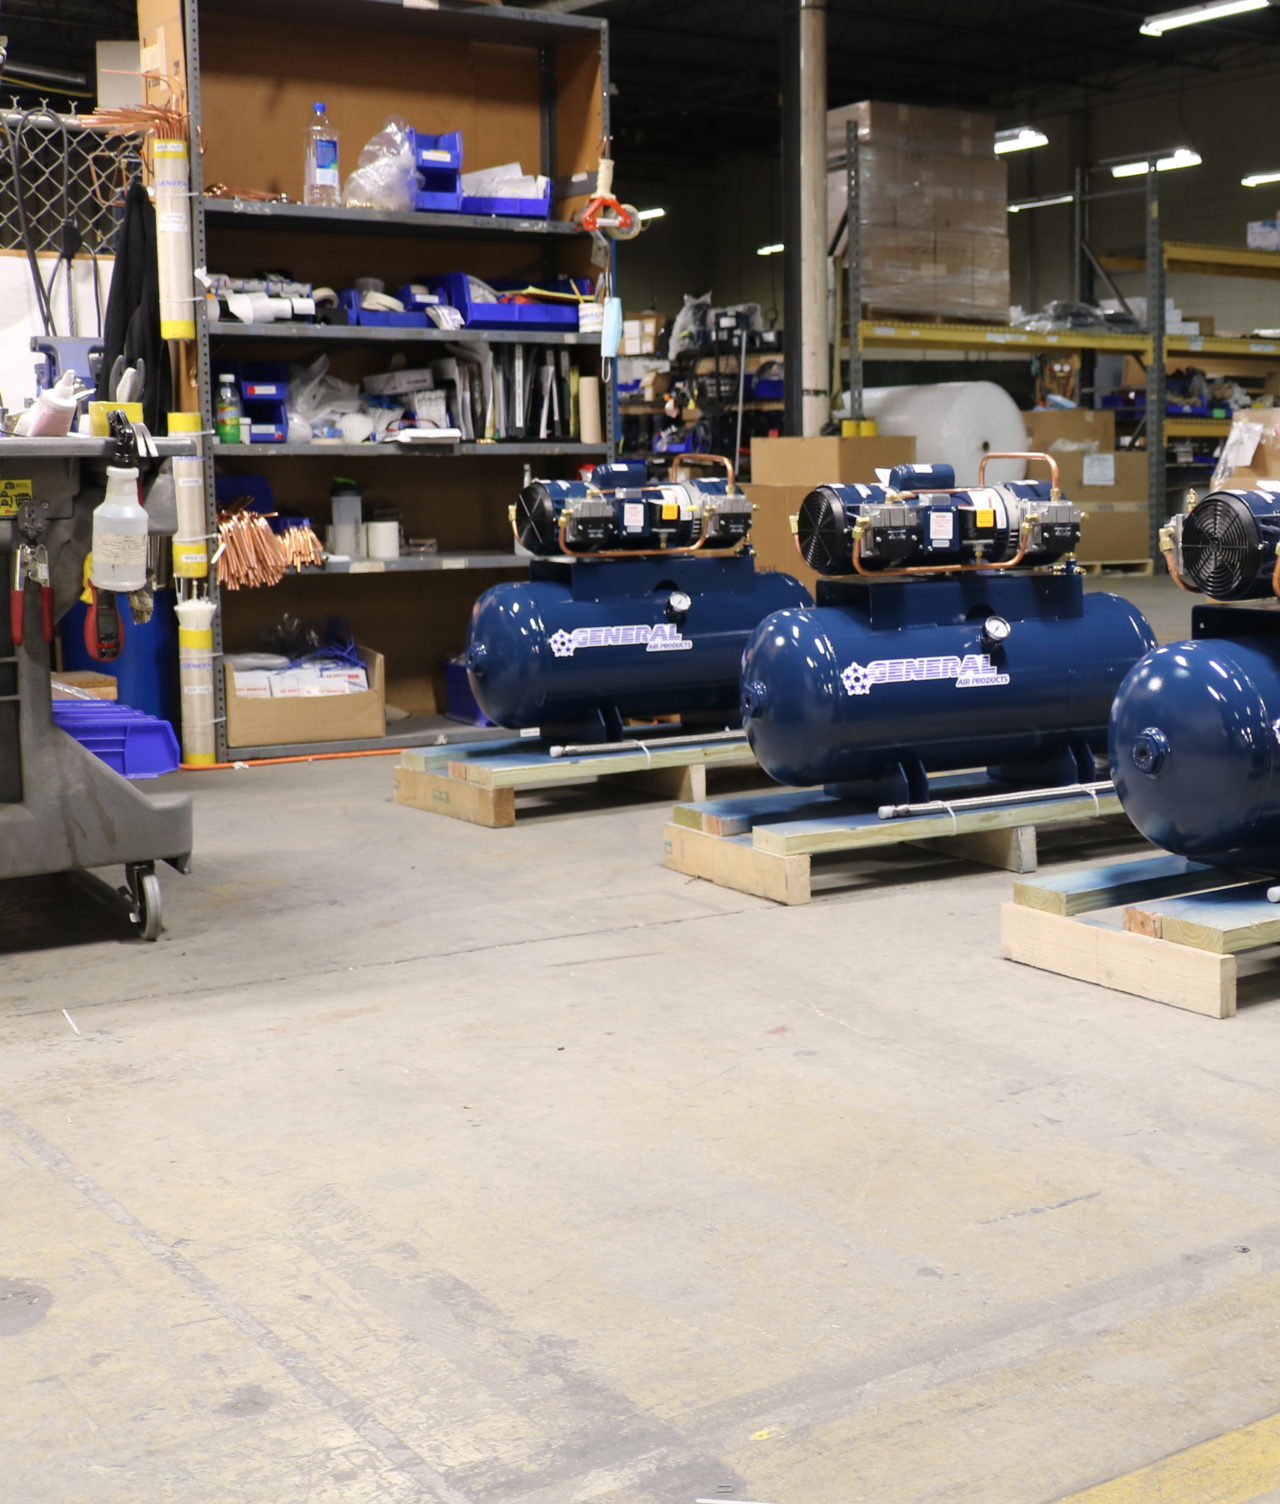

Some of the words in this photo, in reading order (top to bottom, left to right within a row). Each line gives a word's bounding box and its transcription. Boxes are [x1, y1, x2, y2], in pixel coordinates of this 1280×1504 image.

[574, 624, 682, 647] GENERAL
[660, 641, 692, 649] PRODUCTS
[867, 654, 998, 683] GENERAL
[957, 678, 970, 686] AIR
[971, 676, 1008, 685] PRODUCTS
